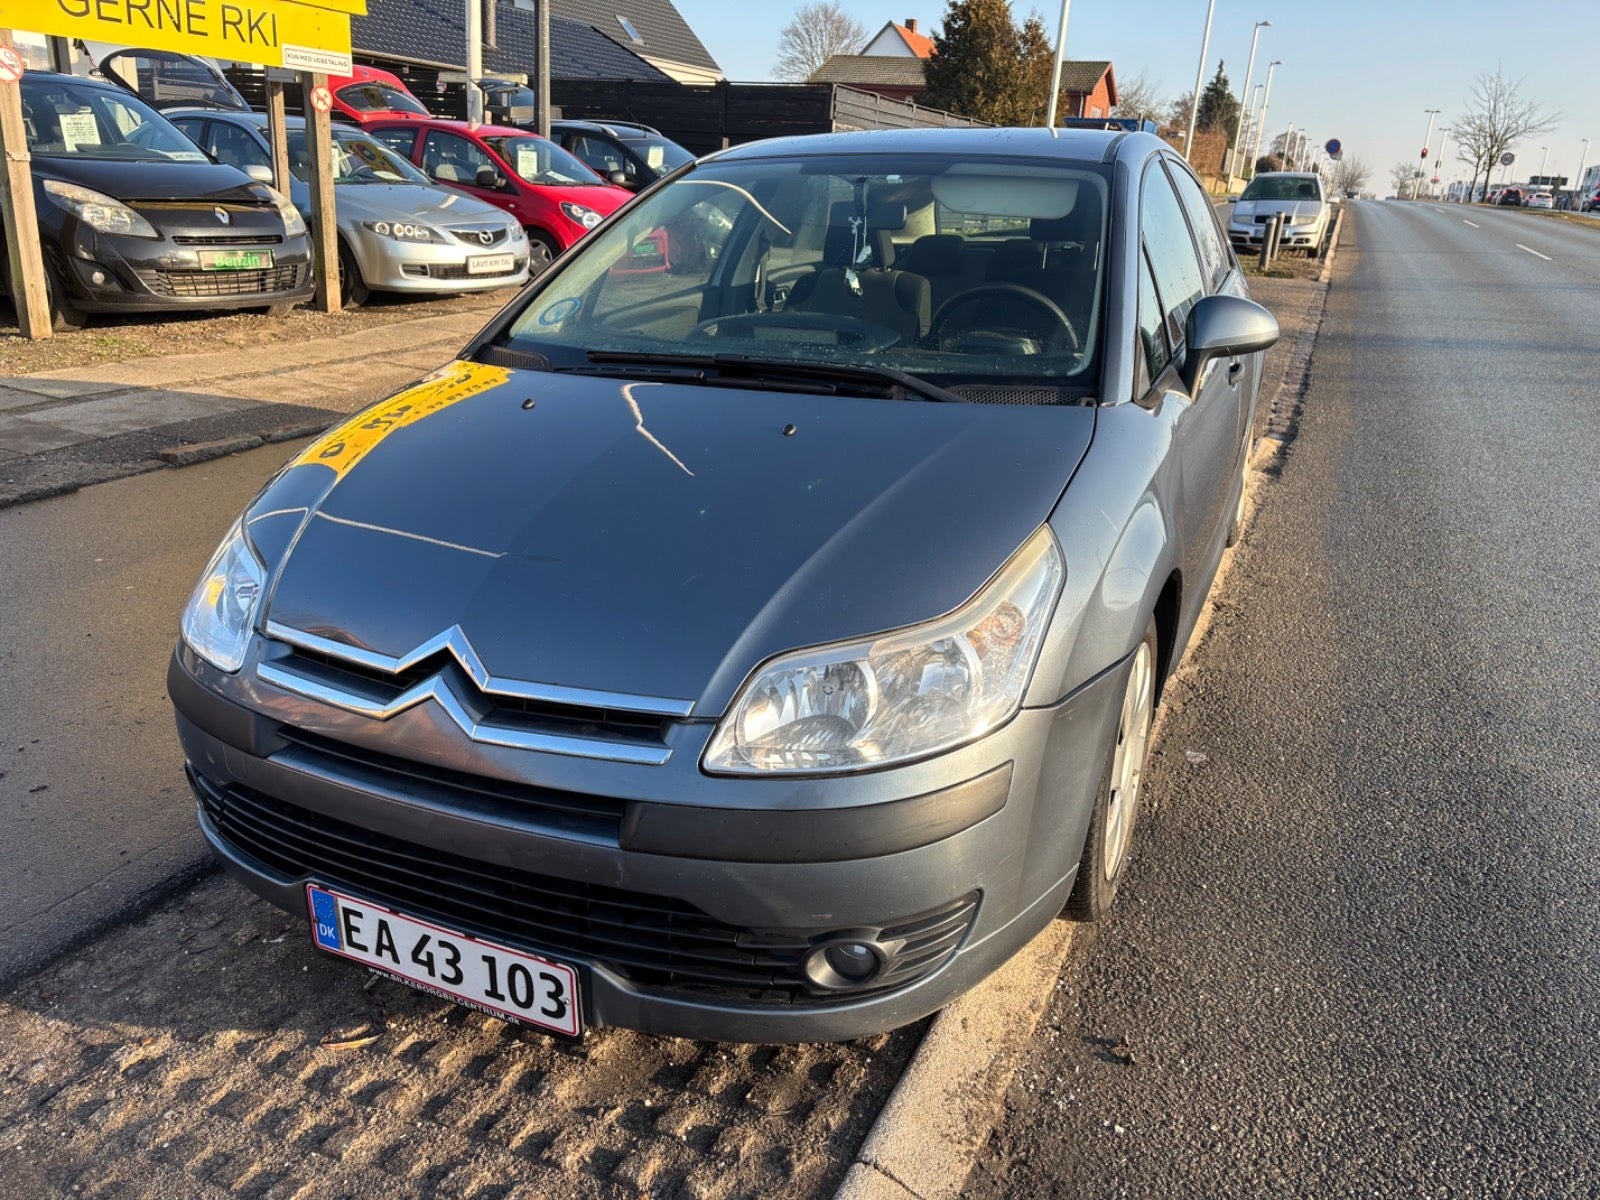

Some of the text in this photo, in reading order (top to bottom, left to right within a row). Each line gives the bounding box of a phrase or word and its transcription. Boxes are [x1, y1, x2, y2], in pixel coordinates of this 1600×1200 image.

[221, 4, 278, 48] RKI
[214, 252, 260, 267] Benzin
[318, 923, 336, 941] DK
[341, 906, 568, 1020] EA 43 103
